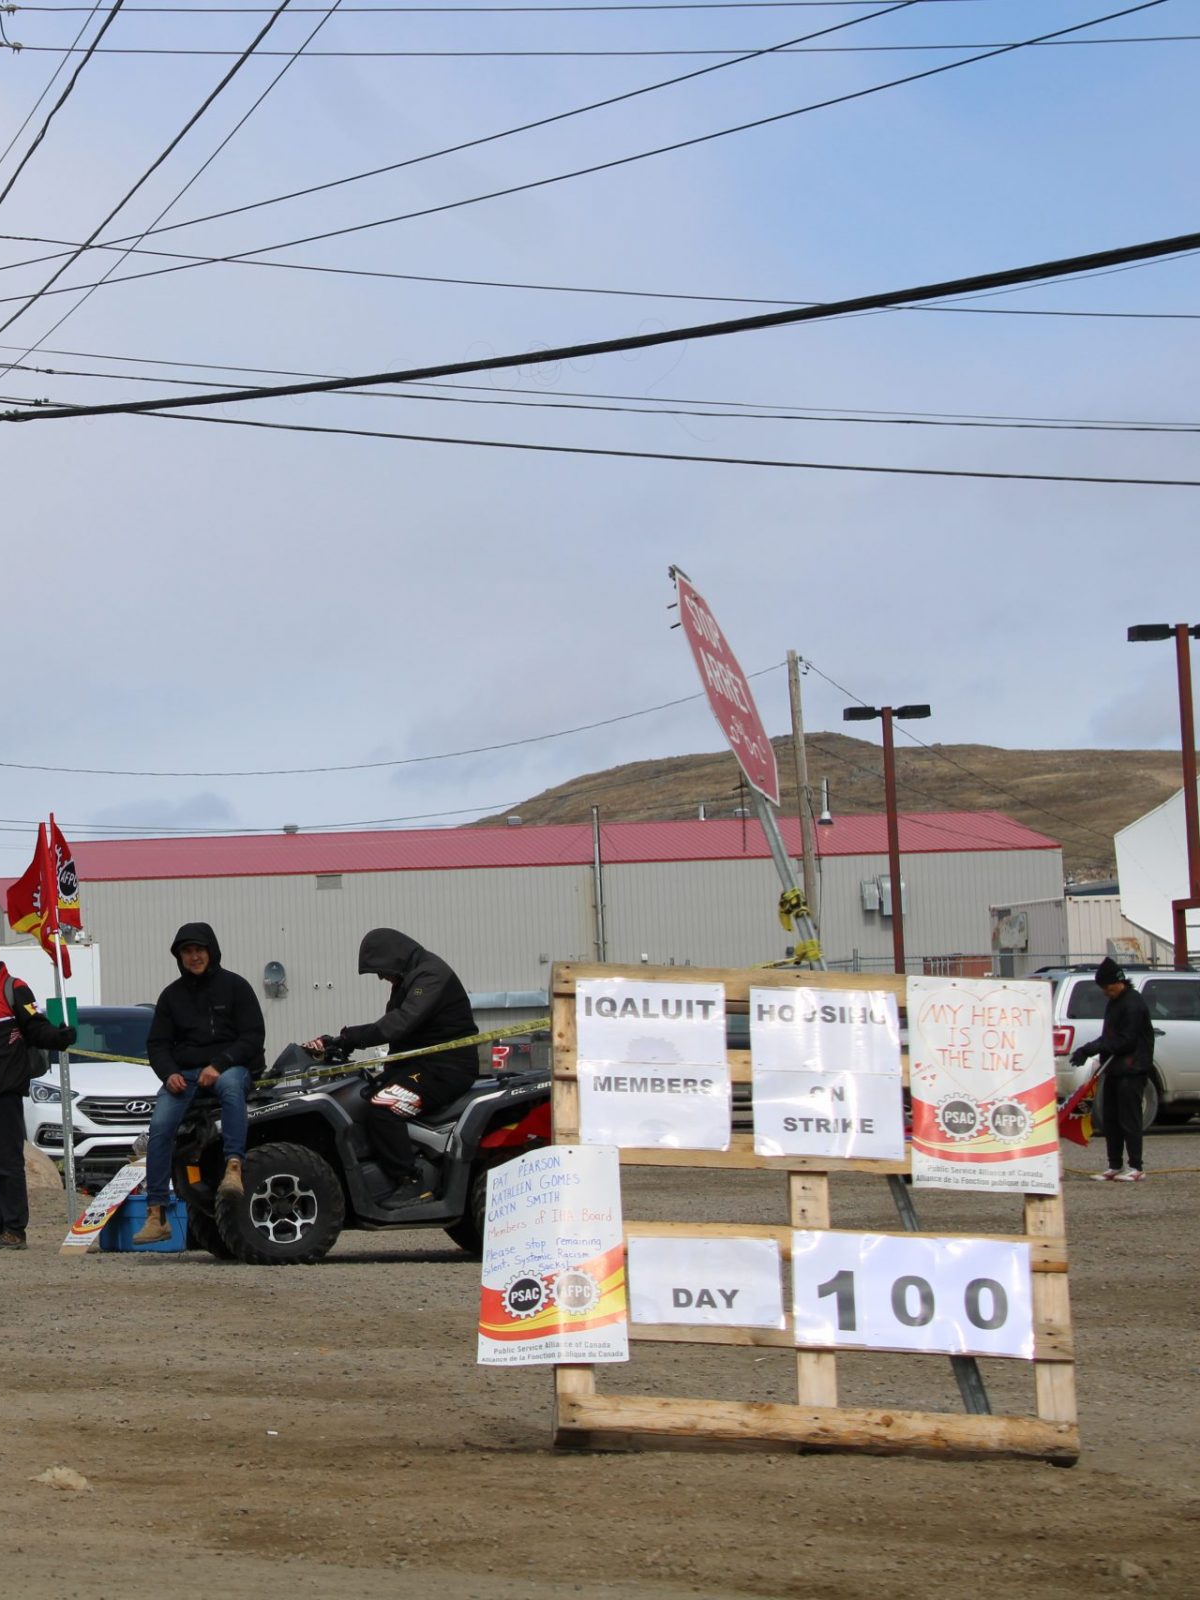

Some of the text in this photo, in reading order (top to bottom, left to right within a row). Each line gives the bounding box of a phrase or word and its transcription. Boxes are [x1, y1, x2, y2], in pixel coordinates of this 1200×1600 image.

[684, 595, 722, 653] STOP
[699, 646, 751, 714] ARRÊT
[584, 996, 716, 1020] IQALUIT
[920, 1003, 1036, 1027] MY HEART
[947, 1026, 1016, 1050] IS ON
[936, 1048, 1024, 1072] THE LINE
[593, 1076, 714, 1095] MEMBERS
[783, 1117, 875, 1134] STRIKE
[944, 1111, 1025, 1128] PSAC AFPC
[492, 1156, 561, 1190] PAT PEARSON
[916, 1174, 942, 1183] Alliance
[943, 1175, 952, 1184] de
[961, 1176, 989, 1186] Fonction
[991, 1178, 1019, 1188] publique
[1031, 1180, 1055, 1189] Canada
[928, 1165, 949, 1174] Public
[951, 1166, 976, 1175] Service
[978, 1167, 1006, 1177] Alliance
[1017, 1169, 1043, 1178] Canada
[491, 1174, 580, 1207] KATHLEEN GOMES
[487, 1191, 560, 1222] CARYN SMITH
[488, 1221, 527, 1239] Members
[535, 1210, 546, 1224] of
[582, 1208, 612, 1221] Board
[486, 1237, 601, 1262] Please stop remaining
[558, 1248, 589, 1259] Racism
[510, 1285, 592, 1303] PSAC AFPC
[672, 1287, 739, 1309] DAY
[817, 1270, 1009, 1331] 100
[493, 1347, 515, 1355] Public
[517, 1344, 543, 1353] Service
[527, 1352, 556, 1361] Fonction
[588, 1350, 596, 1358] du
[598, 1350, 623, 1358] Canada
